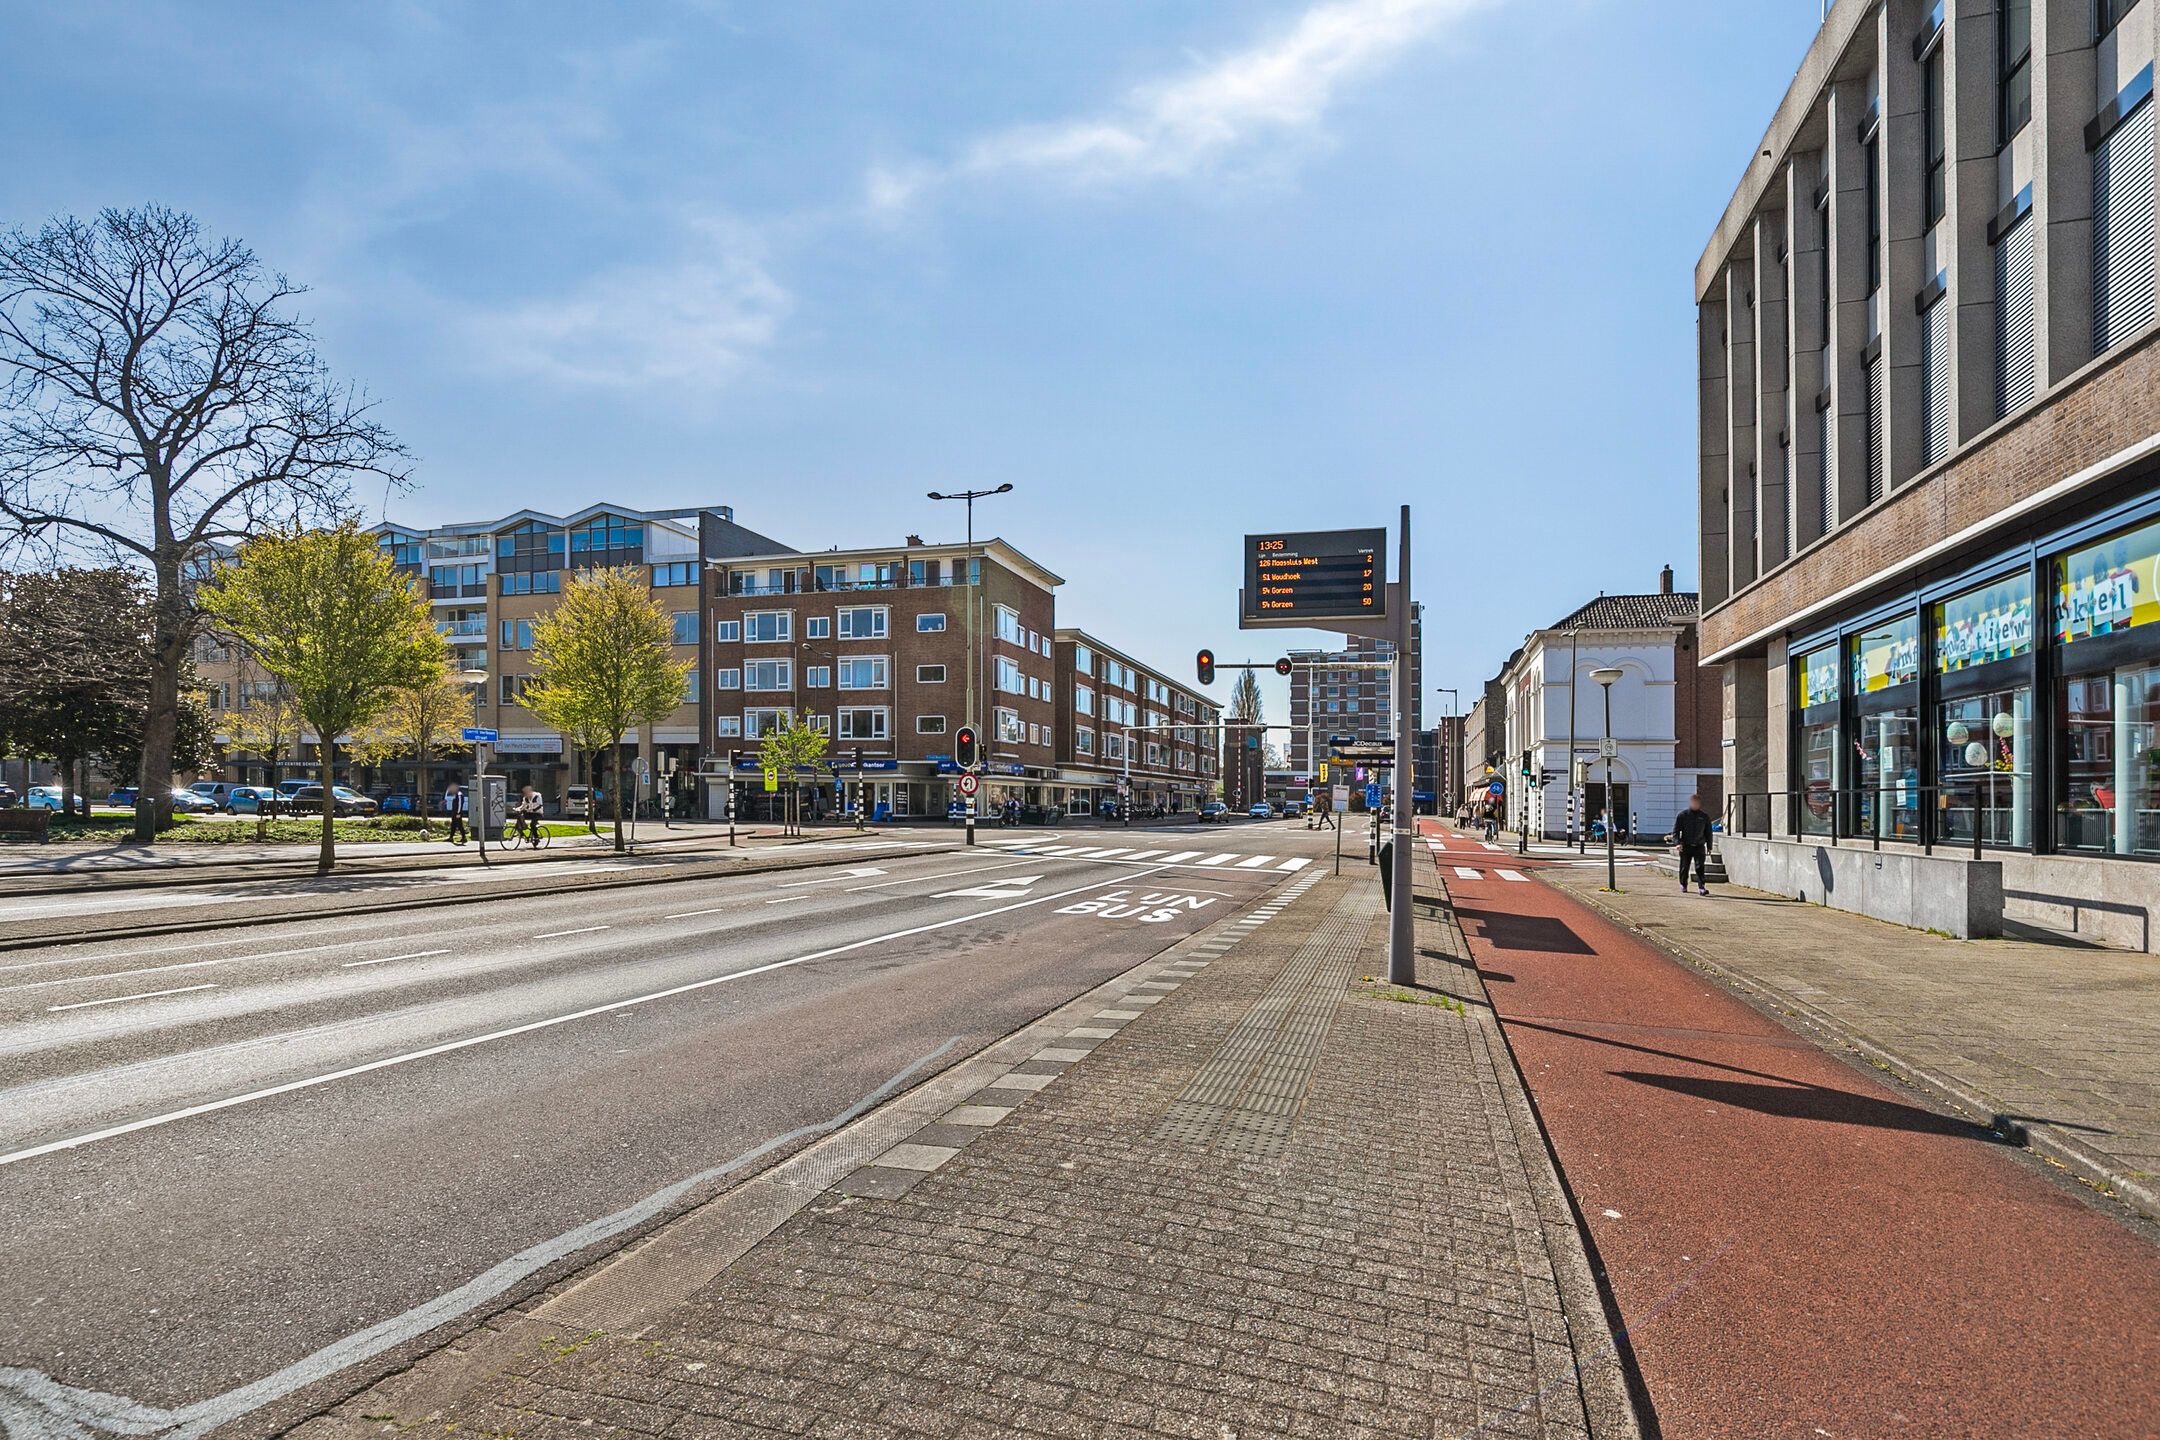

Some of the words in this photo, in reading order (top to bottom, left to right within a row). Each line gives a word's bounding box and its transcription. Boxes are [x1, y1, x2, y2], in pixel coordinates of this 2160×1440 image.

[1259, 541, 1284, 550] 13:25
[1303, 557, 1318, 565] West
[1366, 554, 1373, 563] 2
[1363, 569, 1373, 577] 17
[1362, 583, 1372, 591] 20
[1271, 600, 1294, 608] Gorzen
[1362, 597, 1372, 605] 50
[1051, 901, 1184, 922] BUS
